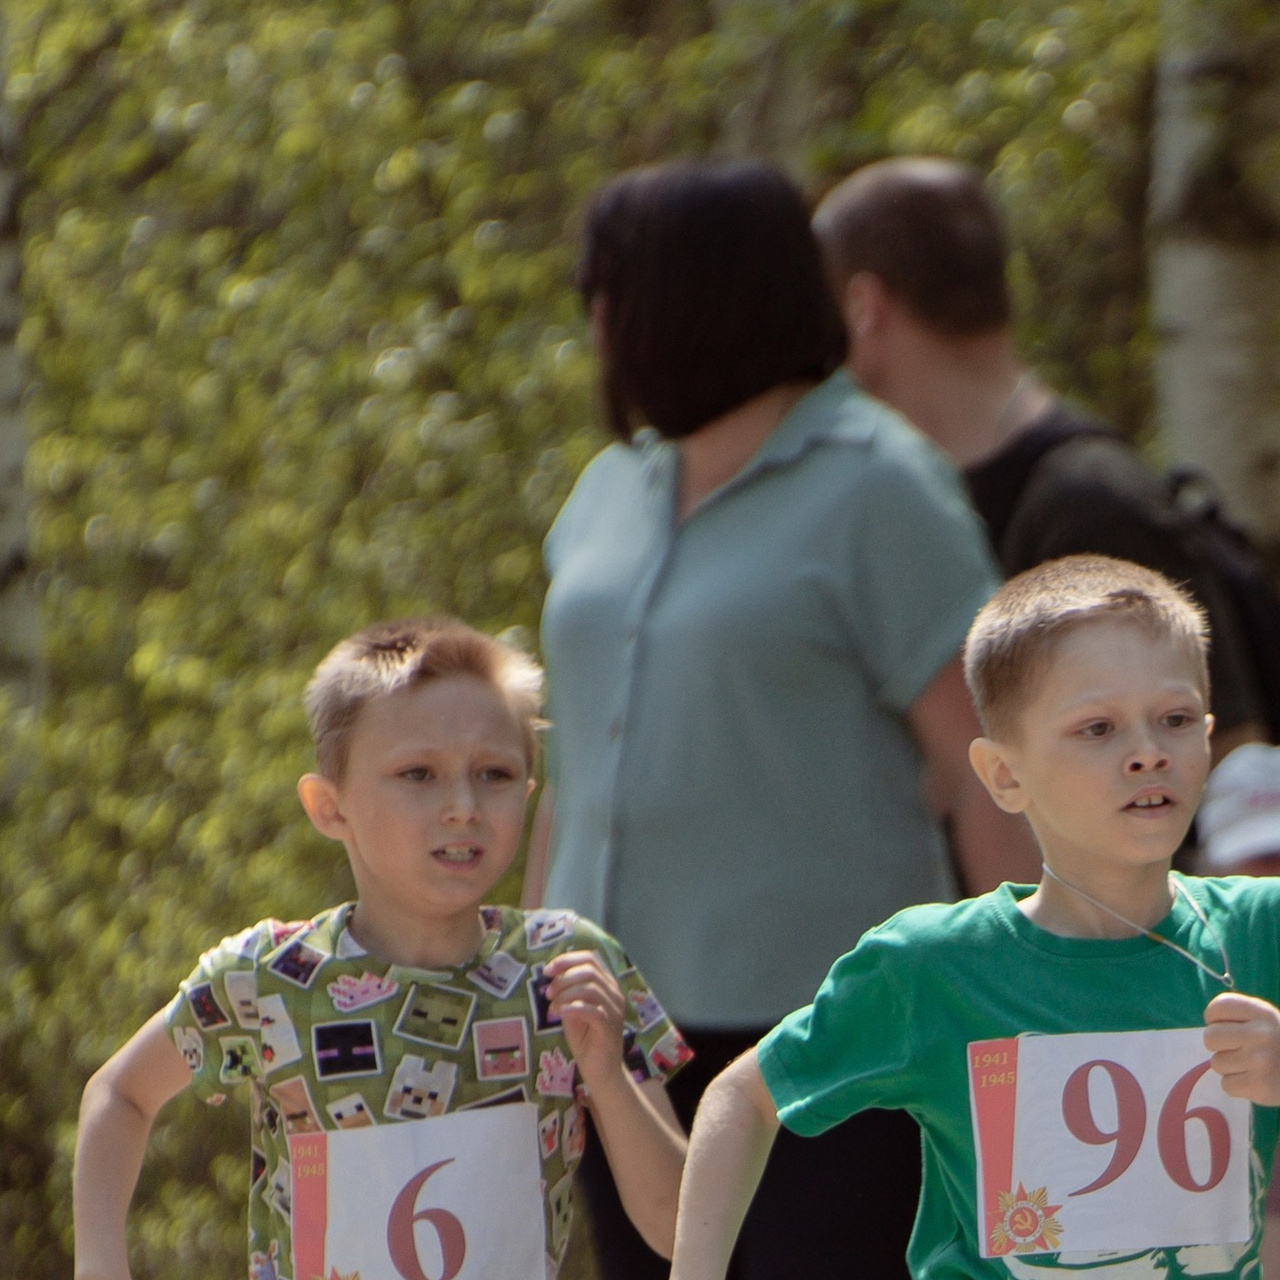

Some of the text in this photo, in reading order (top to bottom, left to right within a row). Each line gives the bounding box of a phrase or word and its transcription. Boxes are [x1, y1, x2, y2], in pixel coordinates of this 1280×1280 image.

[973, 1052, 1008, 1069] 1941
[980, 1071, 1016, 1089] 1945
[1061, 1059, 1231, 1197] 96
